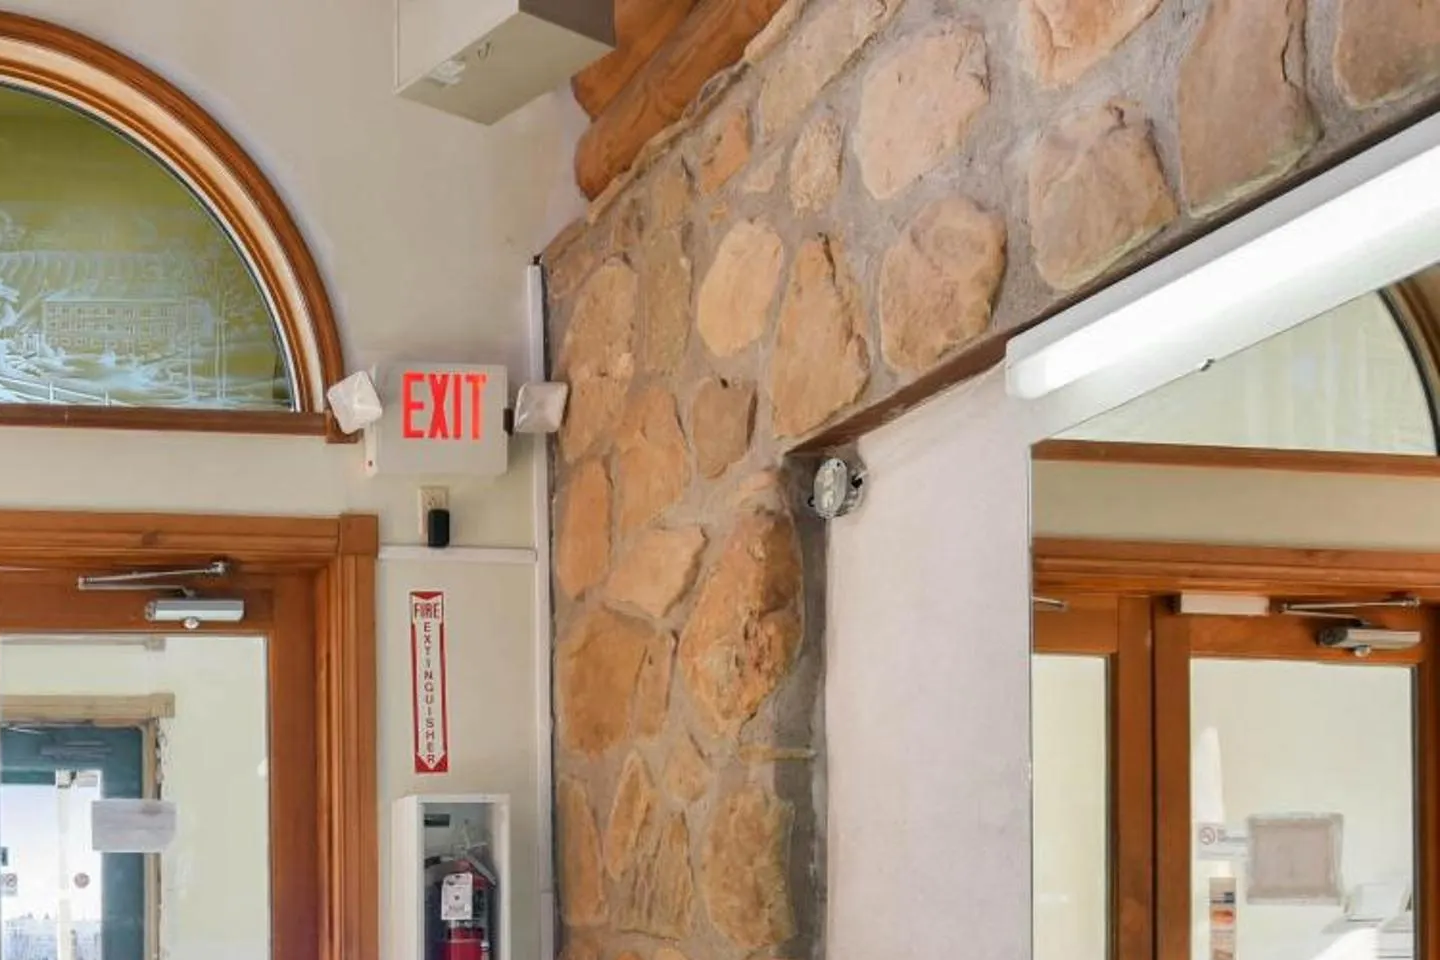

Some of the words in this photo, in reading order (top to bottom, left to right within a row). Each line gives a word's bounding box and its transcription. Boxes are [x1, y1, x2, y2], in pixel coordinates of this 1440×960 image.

[403, 373, 487, 440] EXIT
[414, 603, 439, 619] FIRE
[423, 622, 436, 764] EXTINGUISHER
